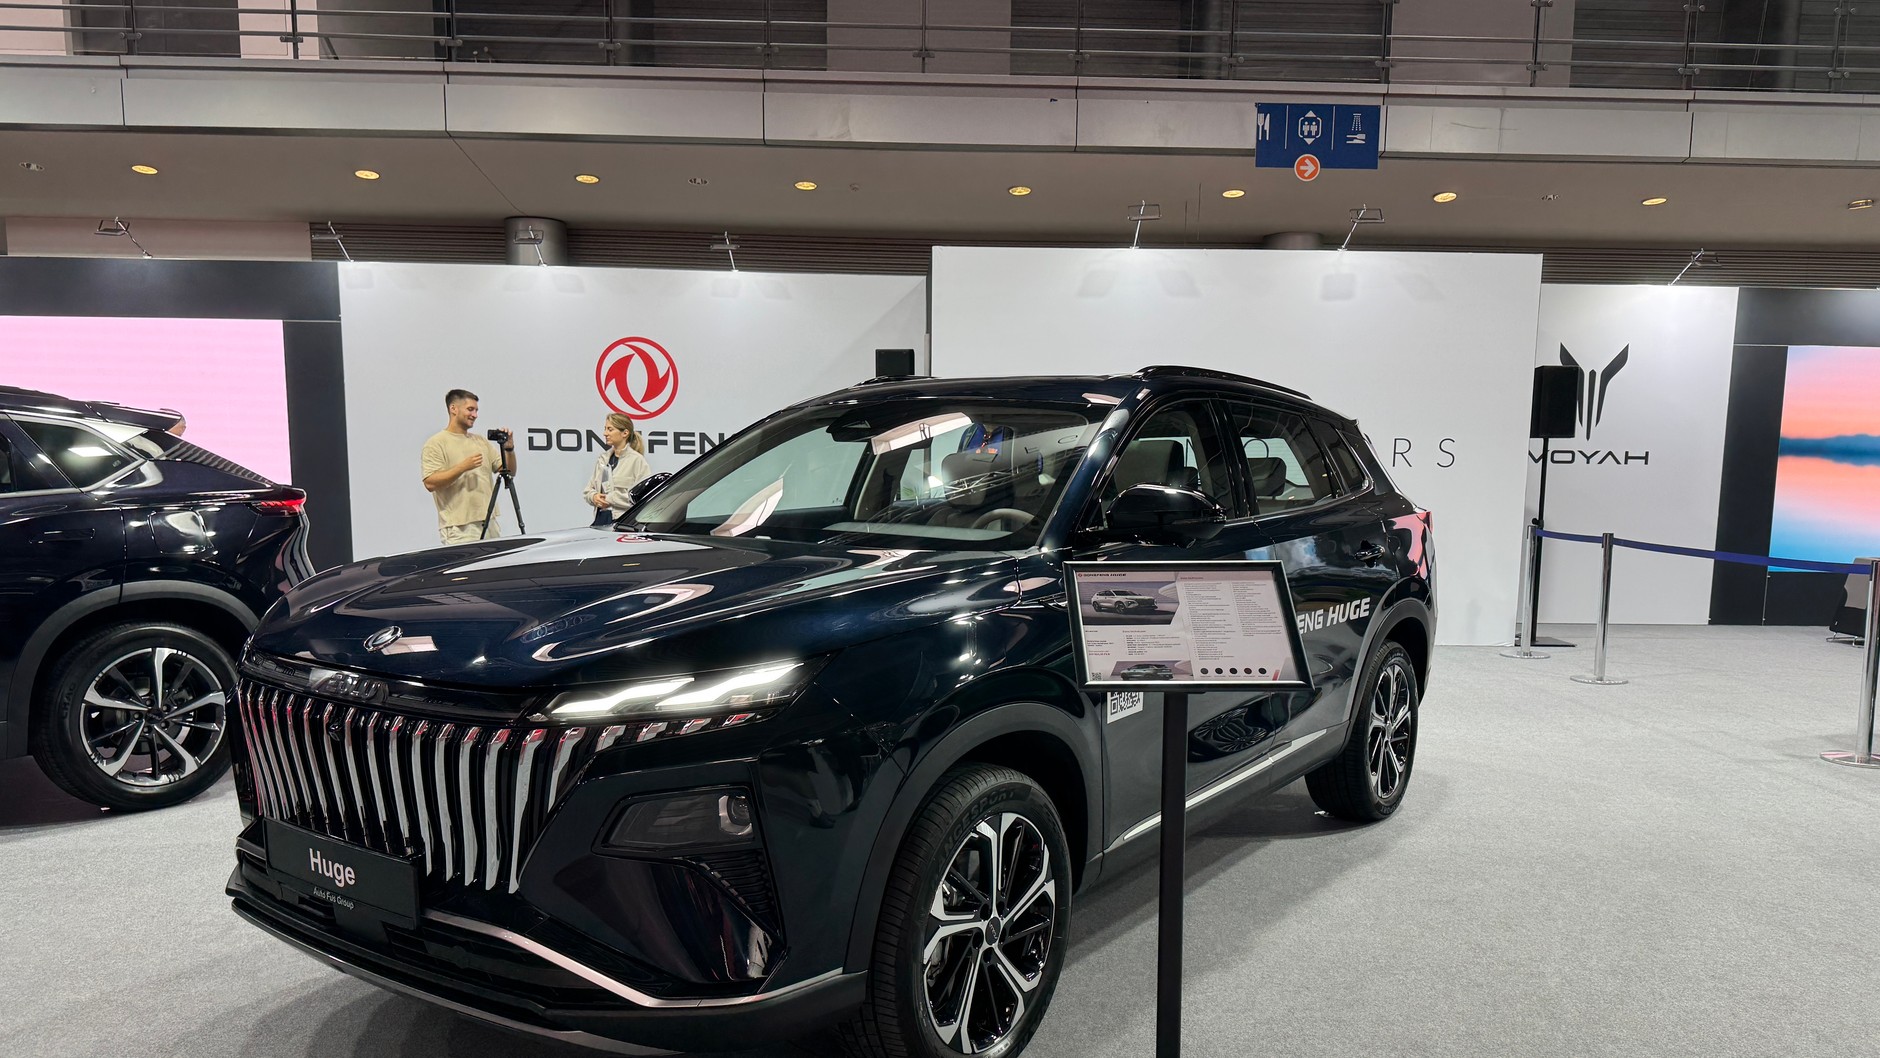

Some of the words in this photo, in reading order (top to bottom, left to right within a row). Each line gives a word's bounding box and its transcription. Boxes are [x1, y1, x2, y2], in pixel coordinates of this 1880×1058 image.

[527, 427, 725, 455] DONFEN
[1528, 450, 1650, 465] VOYAH
[1326, 597, 1371, 627] HUGE
[309, 847, 356, 888] Huge
[336, 895, 355, 911] Group
